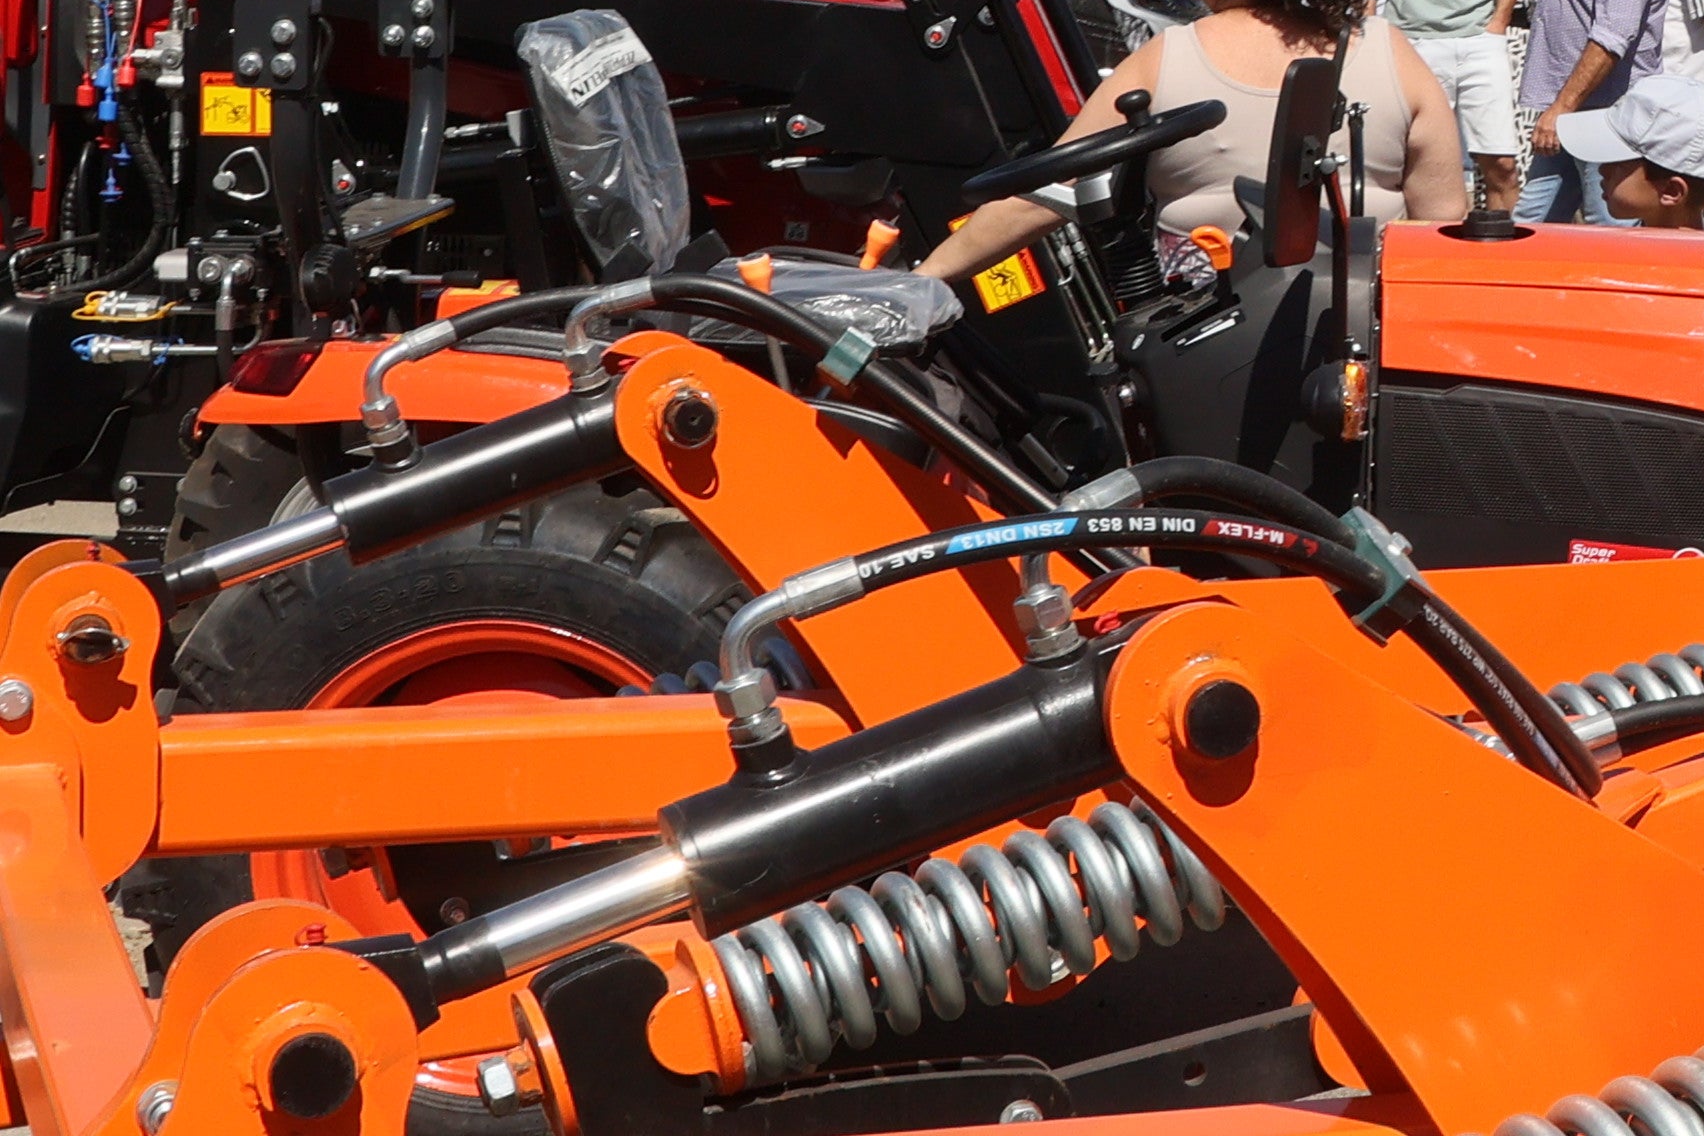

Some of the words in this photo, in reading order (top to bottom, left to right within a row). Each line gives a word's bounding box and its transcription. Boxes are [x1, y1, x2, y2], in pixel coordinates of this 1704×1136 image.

[1024, 521, 1065, 539] 2SN
[1087, 517, 1123, 533] 853
[1129, 517, 1156, 531] EN
[1162, 517, 1195, 532] DIN
[1218, 521, 1285, 545] M-FLEX
[891, 545, 936, 570] SAE
[1571, 544, 1616, 557] Super
